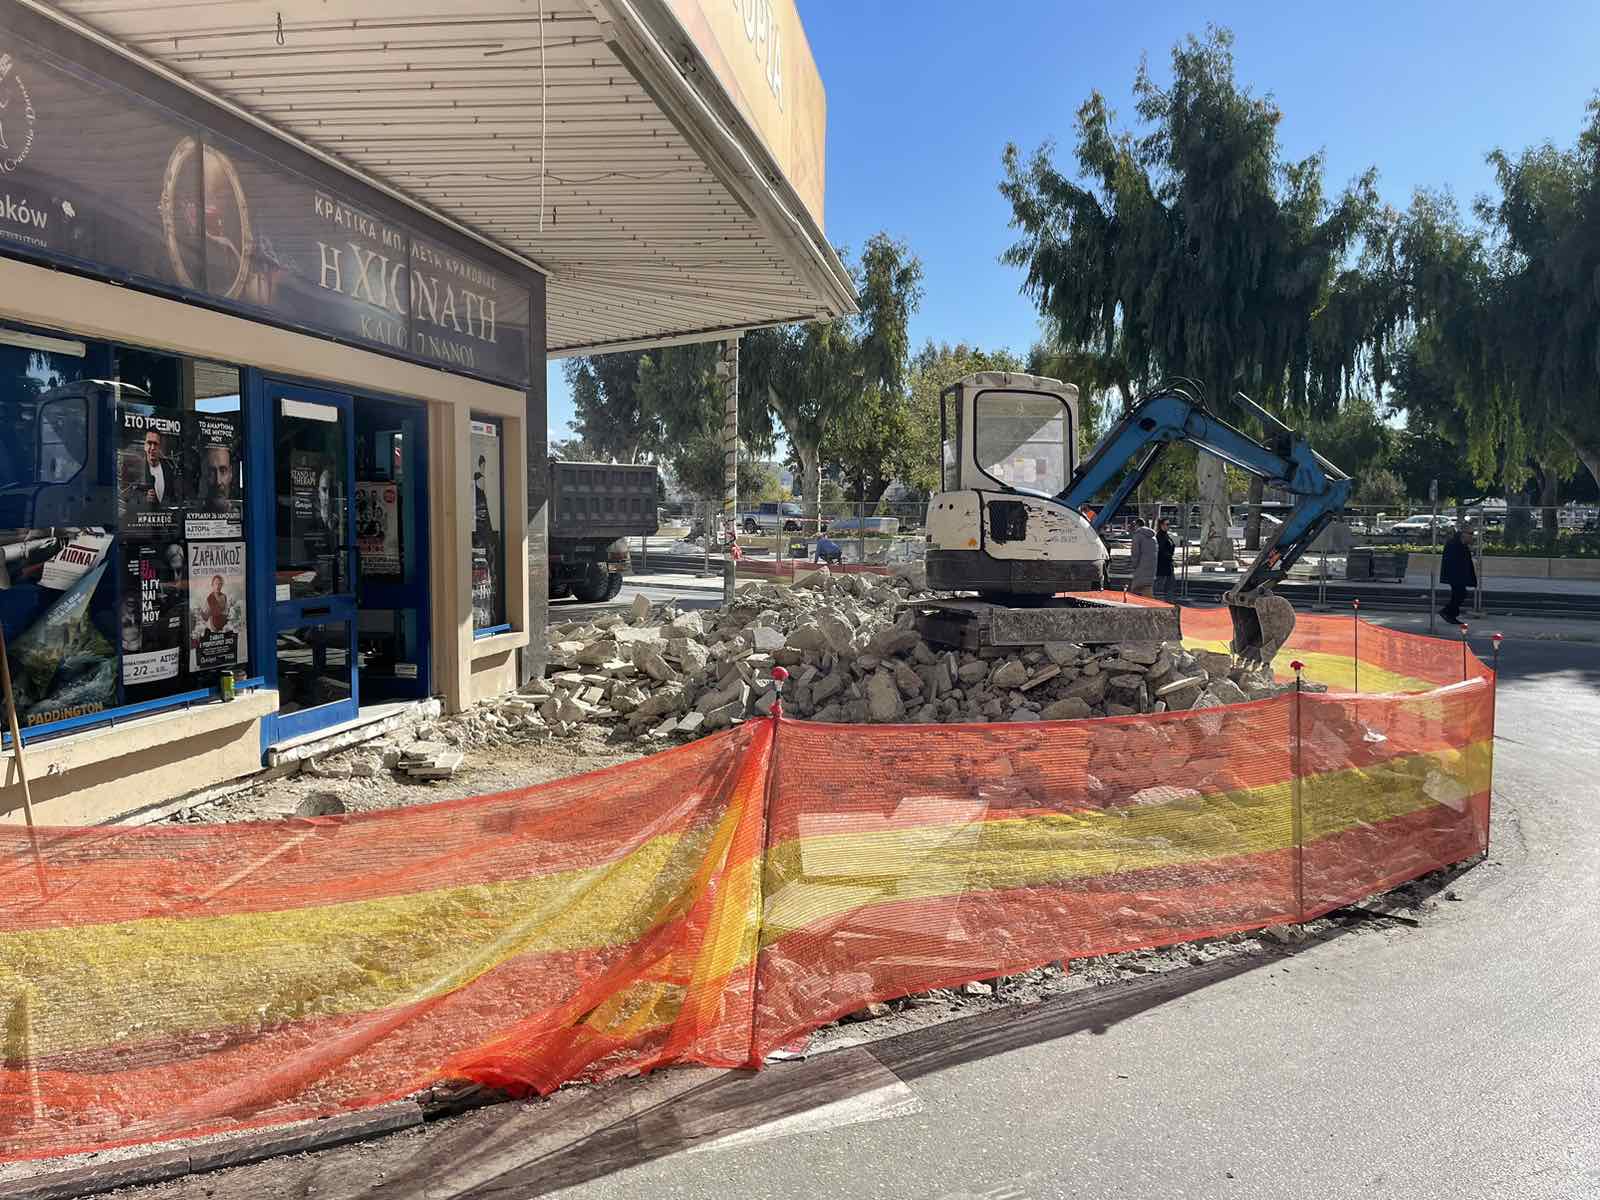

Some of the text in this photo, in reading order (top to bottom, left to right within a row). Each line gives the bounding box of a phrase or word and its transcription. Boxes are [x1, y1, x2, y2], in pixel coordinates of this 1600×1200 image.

[314, 195, 377, 240] ΚΡΑΤΙΚΑ
[317, 241, 497, 344] Η ΧΙΟΝΑΤΗ
[361, 314, 392, 345] ΚΑΙ
[429, 335, 475, 369] ΝΑΝΟΙ
[124, 415, 181, 432] ΣΤΟ ΤΡΕΞΙΜΟ
[142, 590, 156, 601] ΝΑΙ
[142, 601, 153, 611] ΚΑ
[142, 610, 160, 622] ΜΟΥ
[133, 665, 148, 676] 2/2
[27, 701, 104, 726] PADDINGTON
